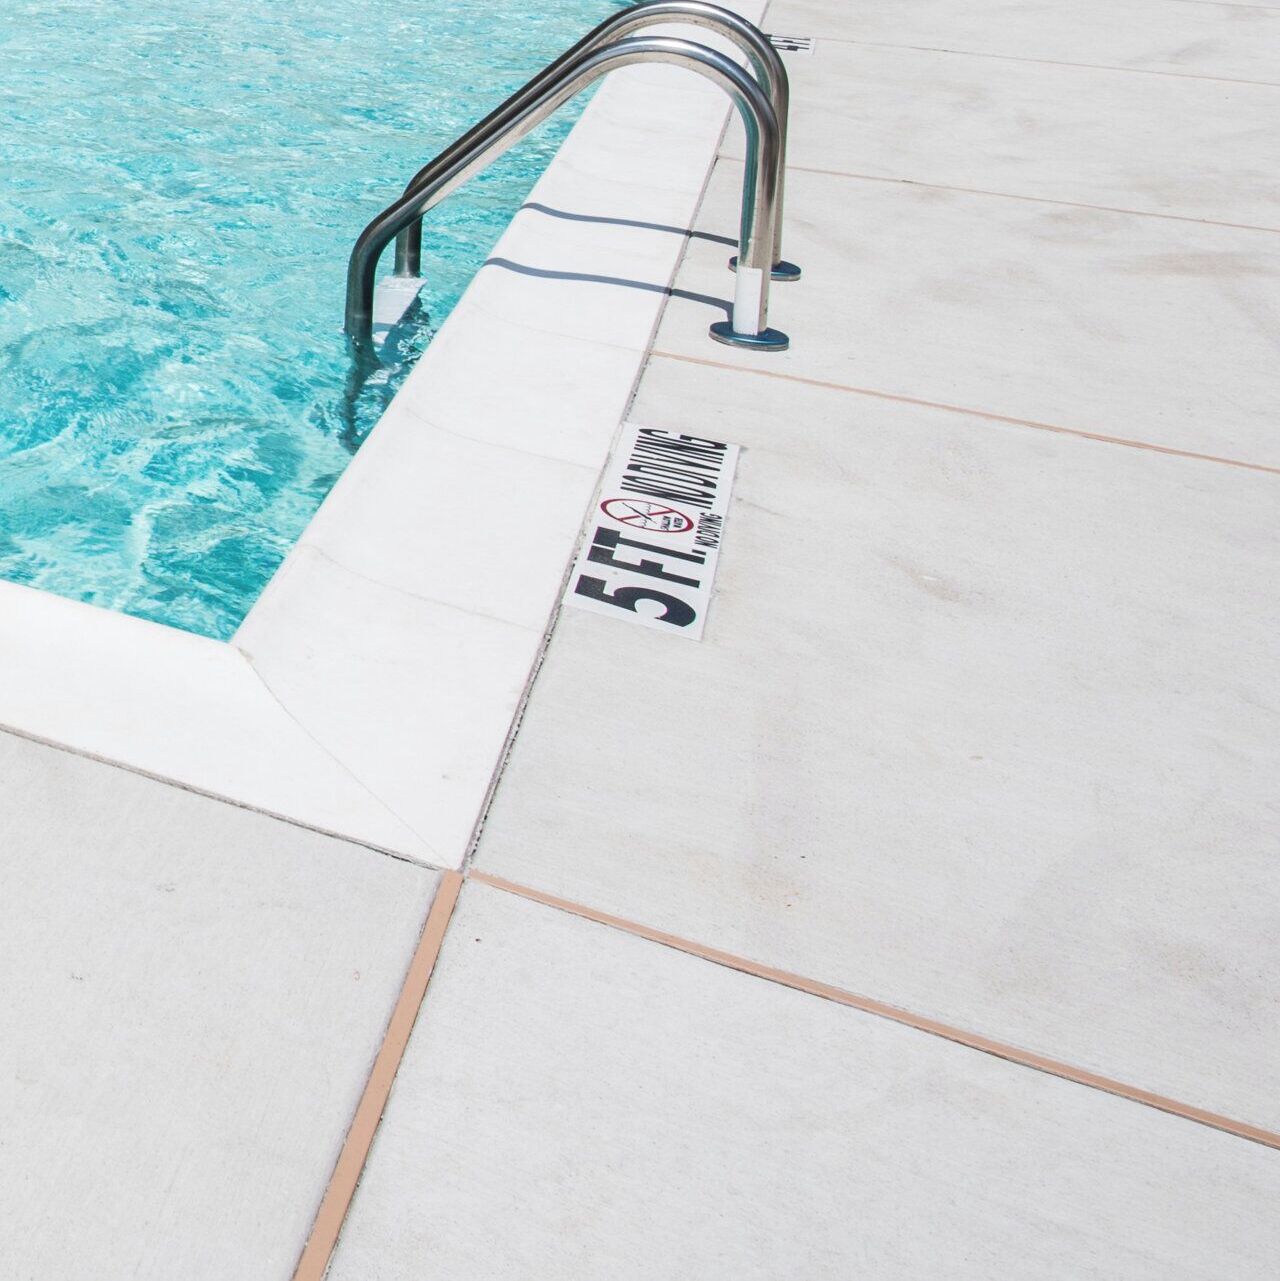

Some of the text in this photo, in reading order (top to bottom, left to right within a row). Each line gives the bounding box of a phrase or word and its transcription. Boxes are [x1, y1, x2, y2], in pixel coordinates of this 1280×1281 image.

[620, 428, 728, 510] NO DIVING
[694, 512, 723, 549] NO DIVING
[574, 526, 706, 627] 5 FT.
